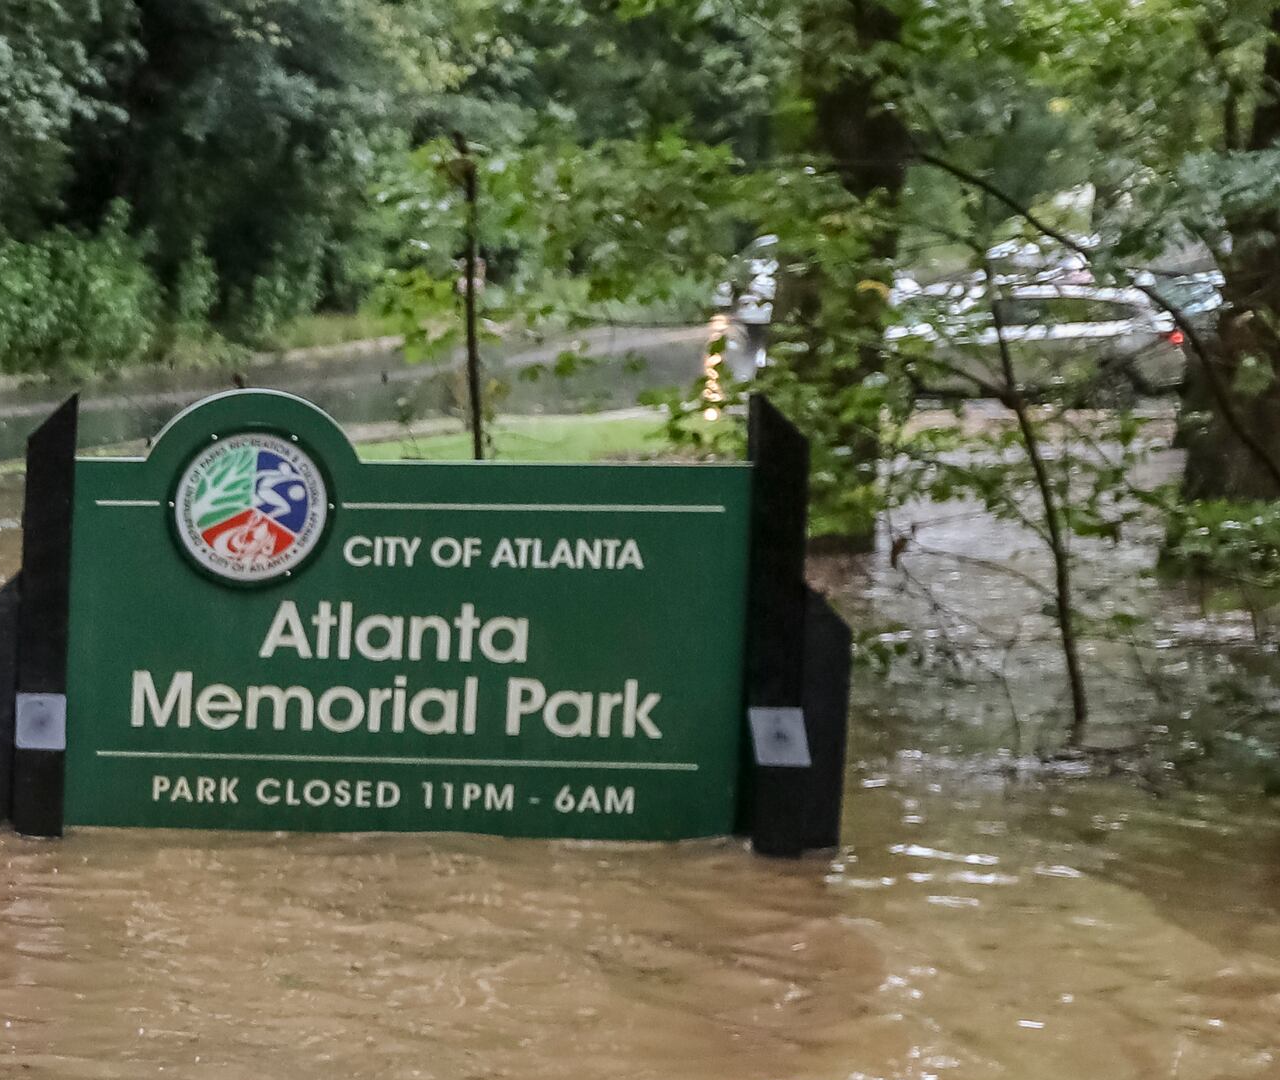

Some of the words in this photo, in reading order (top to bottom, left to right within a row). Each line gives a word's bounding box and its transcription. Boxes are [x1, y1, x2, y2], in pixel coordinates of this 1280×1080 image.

[200, 448, 227, 469] PARKS
[208, 553, 229, 567] CITY
[250, 553, 290, 572] ATLANTA
[342, 535, 422, 568] CITY
[430, 536, 482, 569] OF
[490, 537, 644, 571] ATLANTA
[258, 600, 530, 664] Atlanta
[130, 669, 480, 736] Memorial
[505, 676, 663, 739] Park
[151, 774, 240, 804] PARK
[255, 777, 402, 808] CLOSED
[422, 781, 515, 812] 11PM
[554, 785, 637, 815] 6AM
